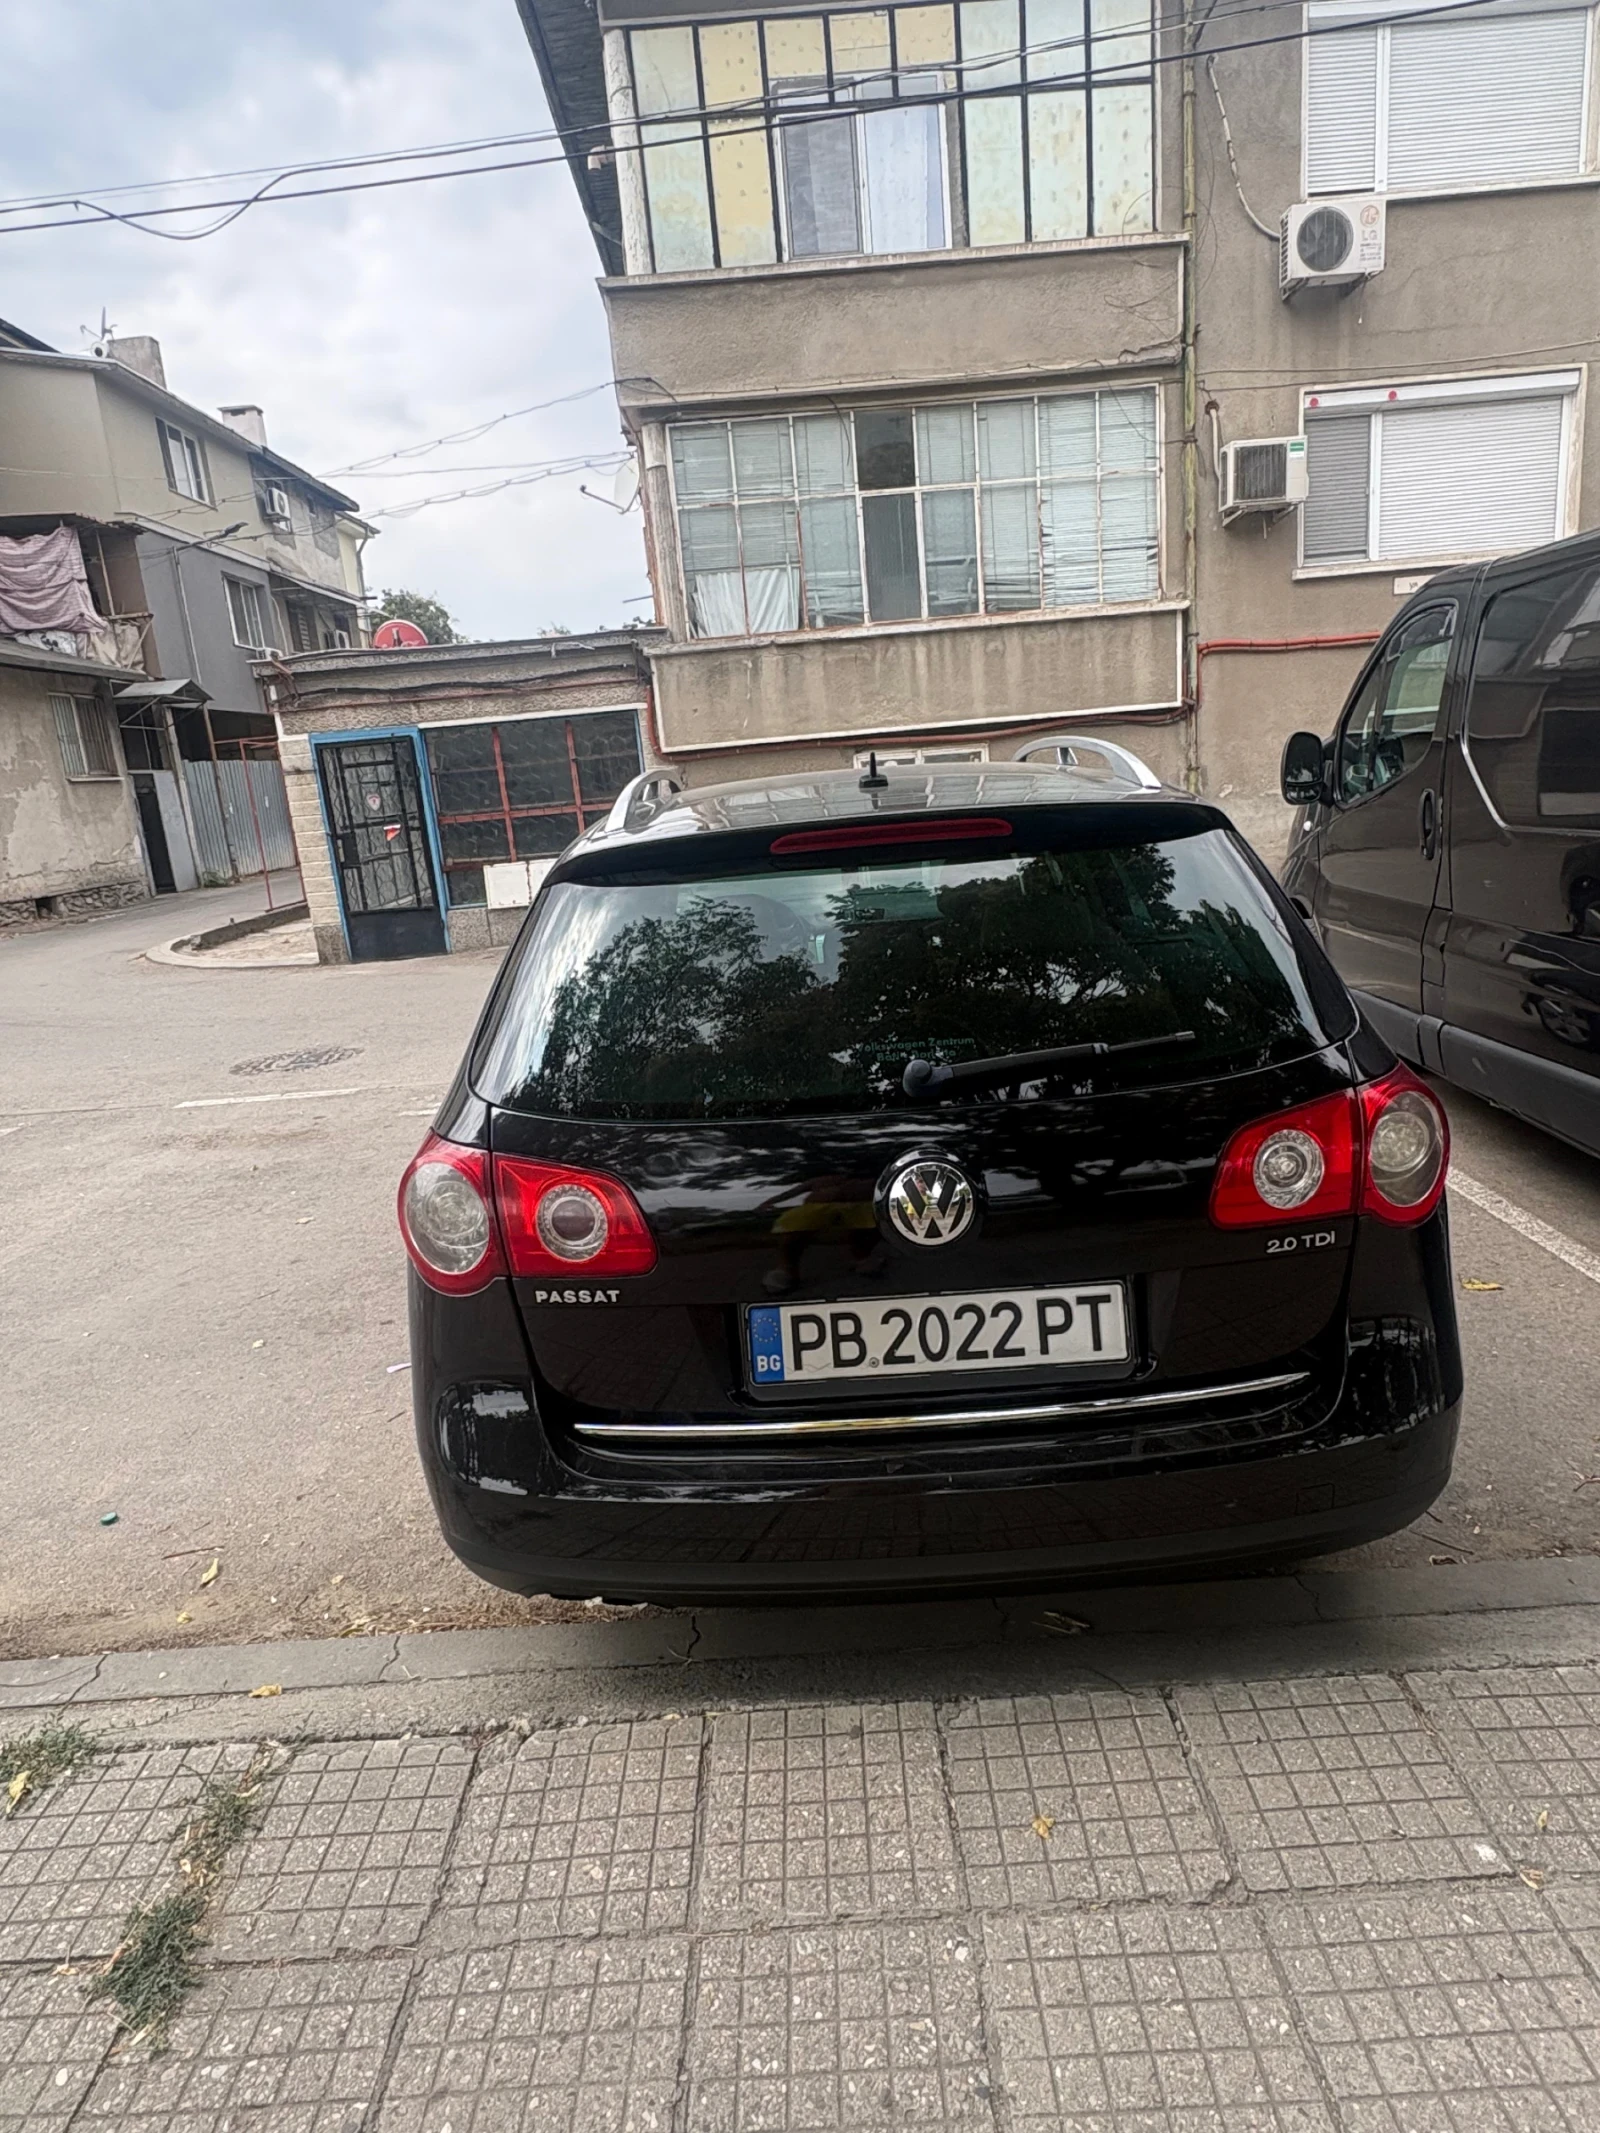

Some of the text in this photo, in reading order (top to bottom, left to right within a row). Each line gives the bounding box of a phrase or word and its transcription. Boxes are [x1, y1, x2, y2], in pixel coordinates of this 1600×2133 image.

[1361, 229, 1377, 241] LG
[859, 1037, 975, 1053] Volkswagen Zentrum
[1301, 1230, 1335, 1248] TDI
[535, 1290, 620, 1303] PASSAT
[756, 1354, 781, 1372] BG
